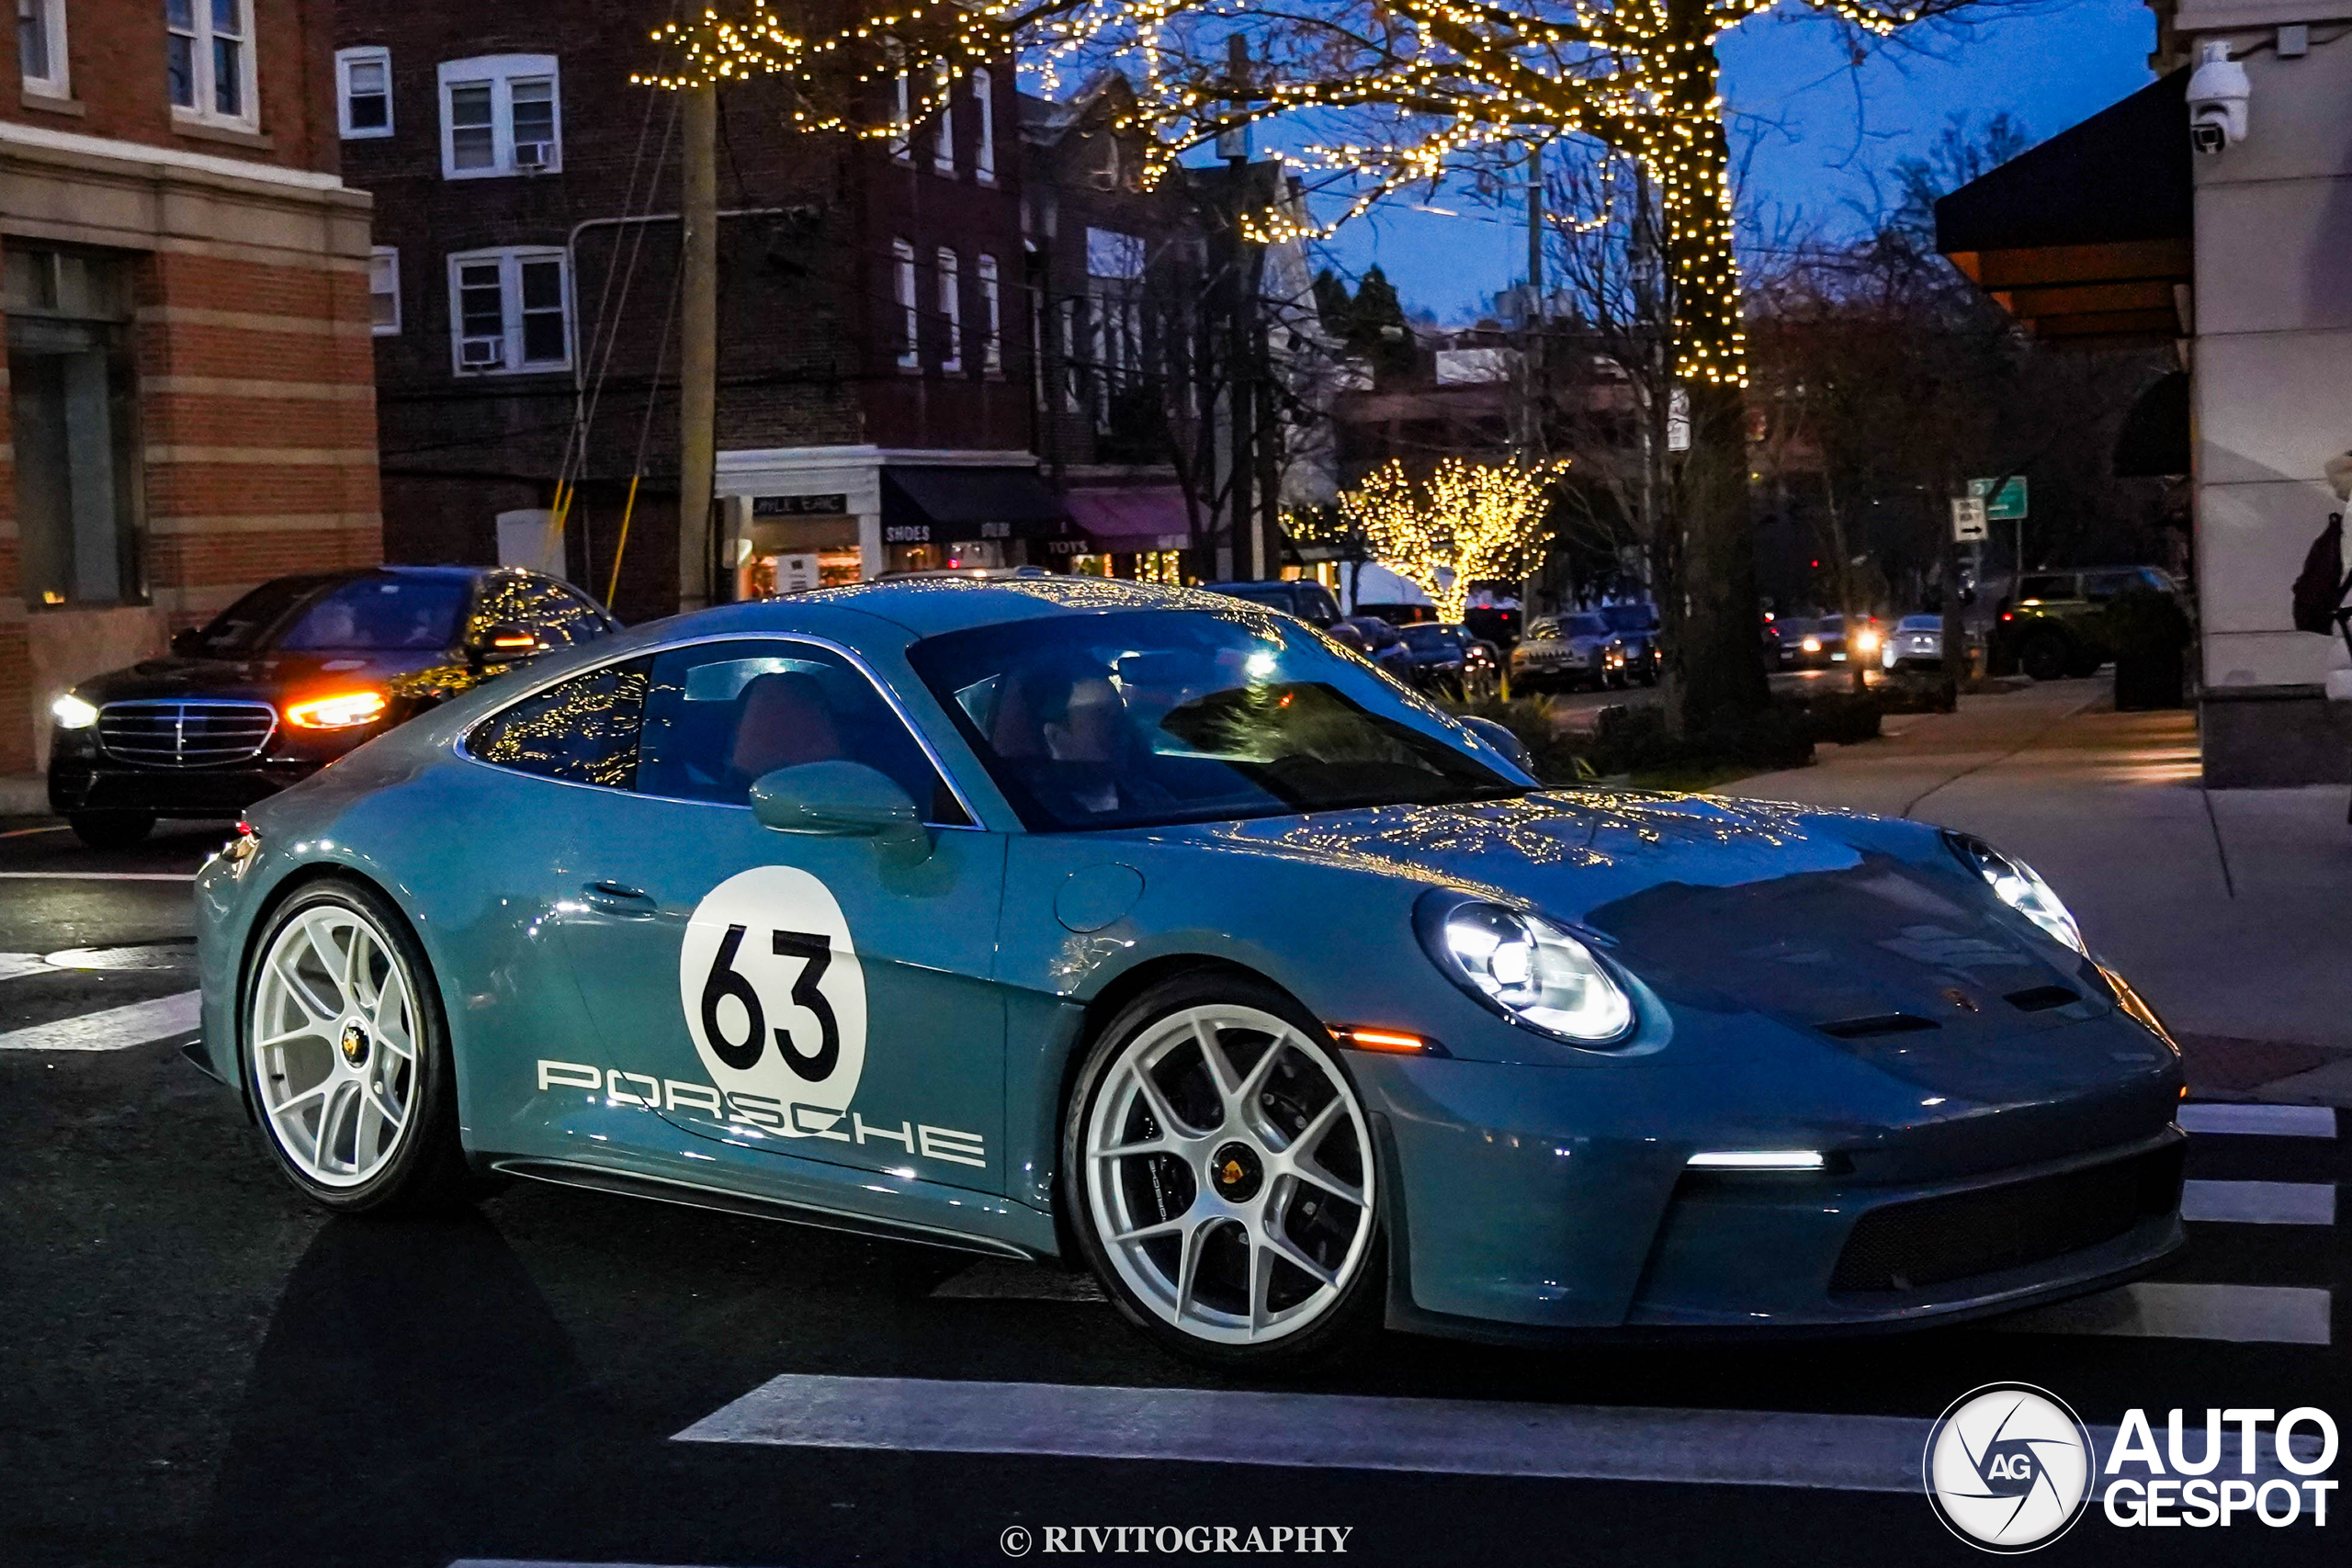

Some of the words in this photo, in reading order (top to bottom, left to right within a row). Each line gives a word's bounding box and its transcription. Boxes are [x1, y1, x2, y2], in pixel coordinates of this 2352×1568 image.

[886, 525, 931, 542] SHOES
[1047, 540, 1089, 554] TOYS
[701, 923, 840, 1083] 63
[537, 1059, 987, 1168] PORSCHE
